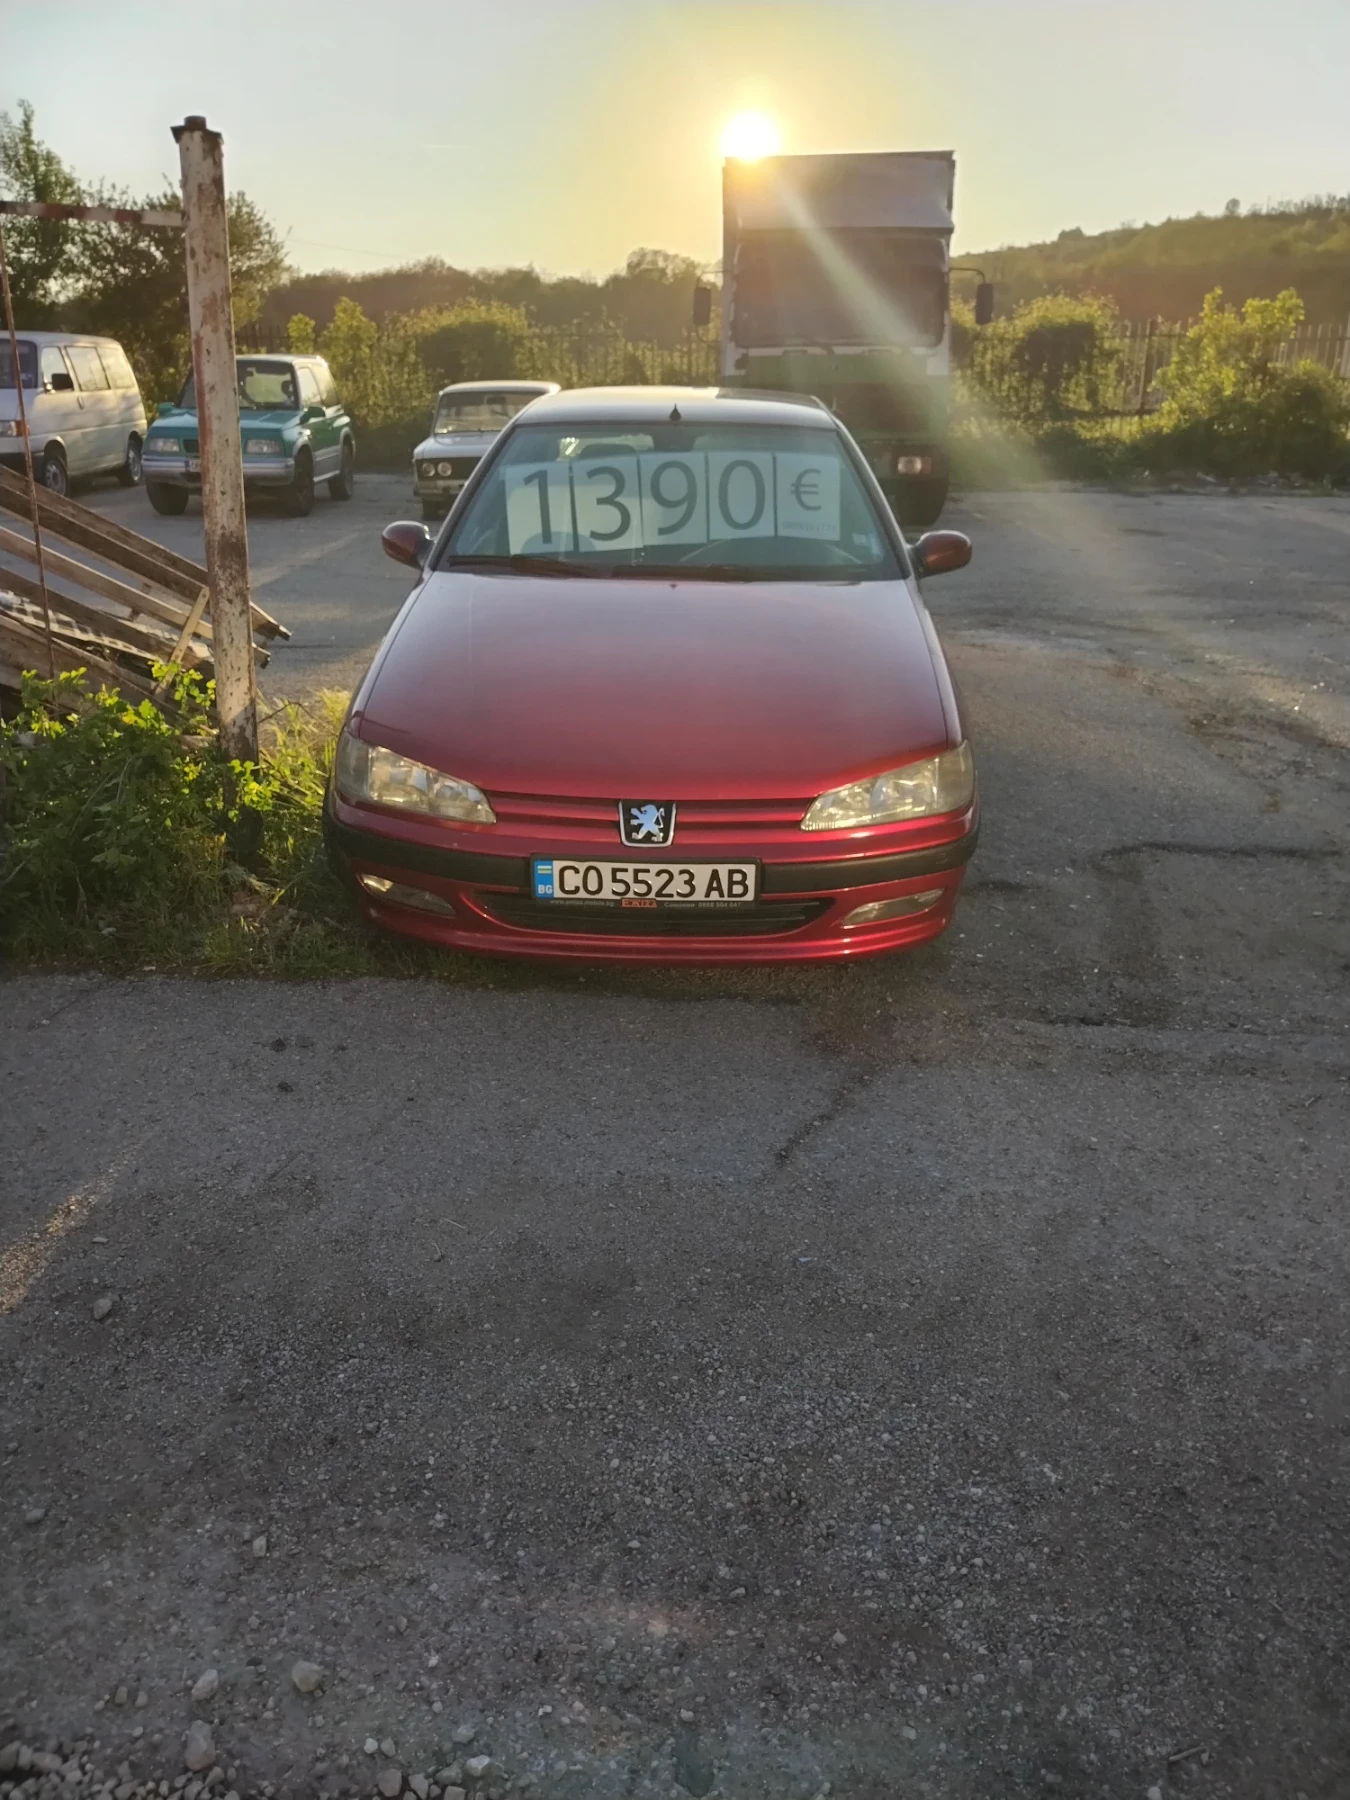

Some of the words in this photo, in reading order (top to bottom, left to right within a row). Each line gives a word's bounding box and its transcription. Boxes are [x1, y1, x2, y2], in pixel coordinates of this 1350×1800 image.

[537, 885, 553, 895] BG
[611, 867, 696, 898] 5523
[704, 868, 749, 898] AB
